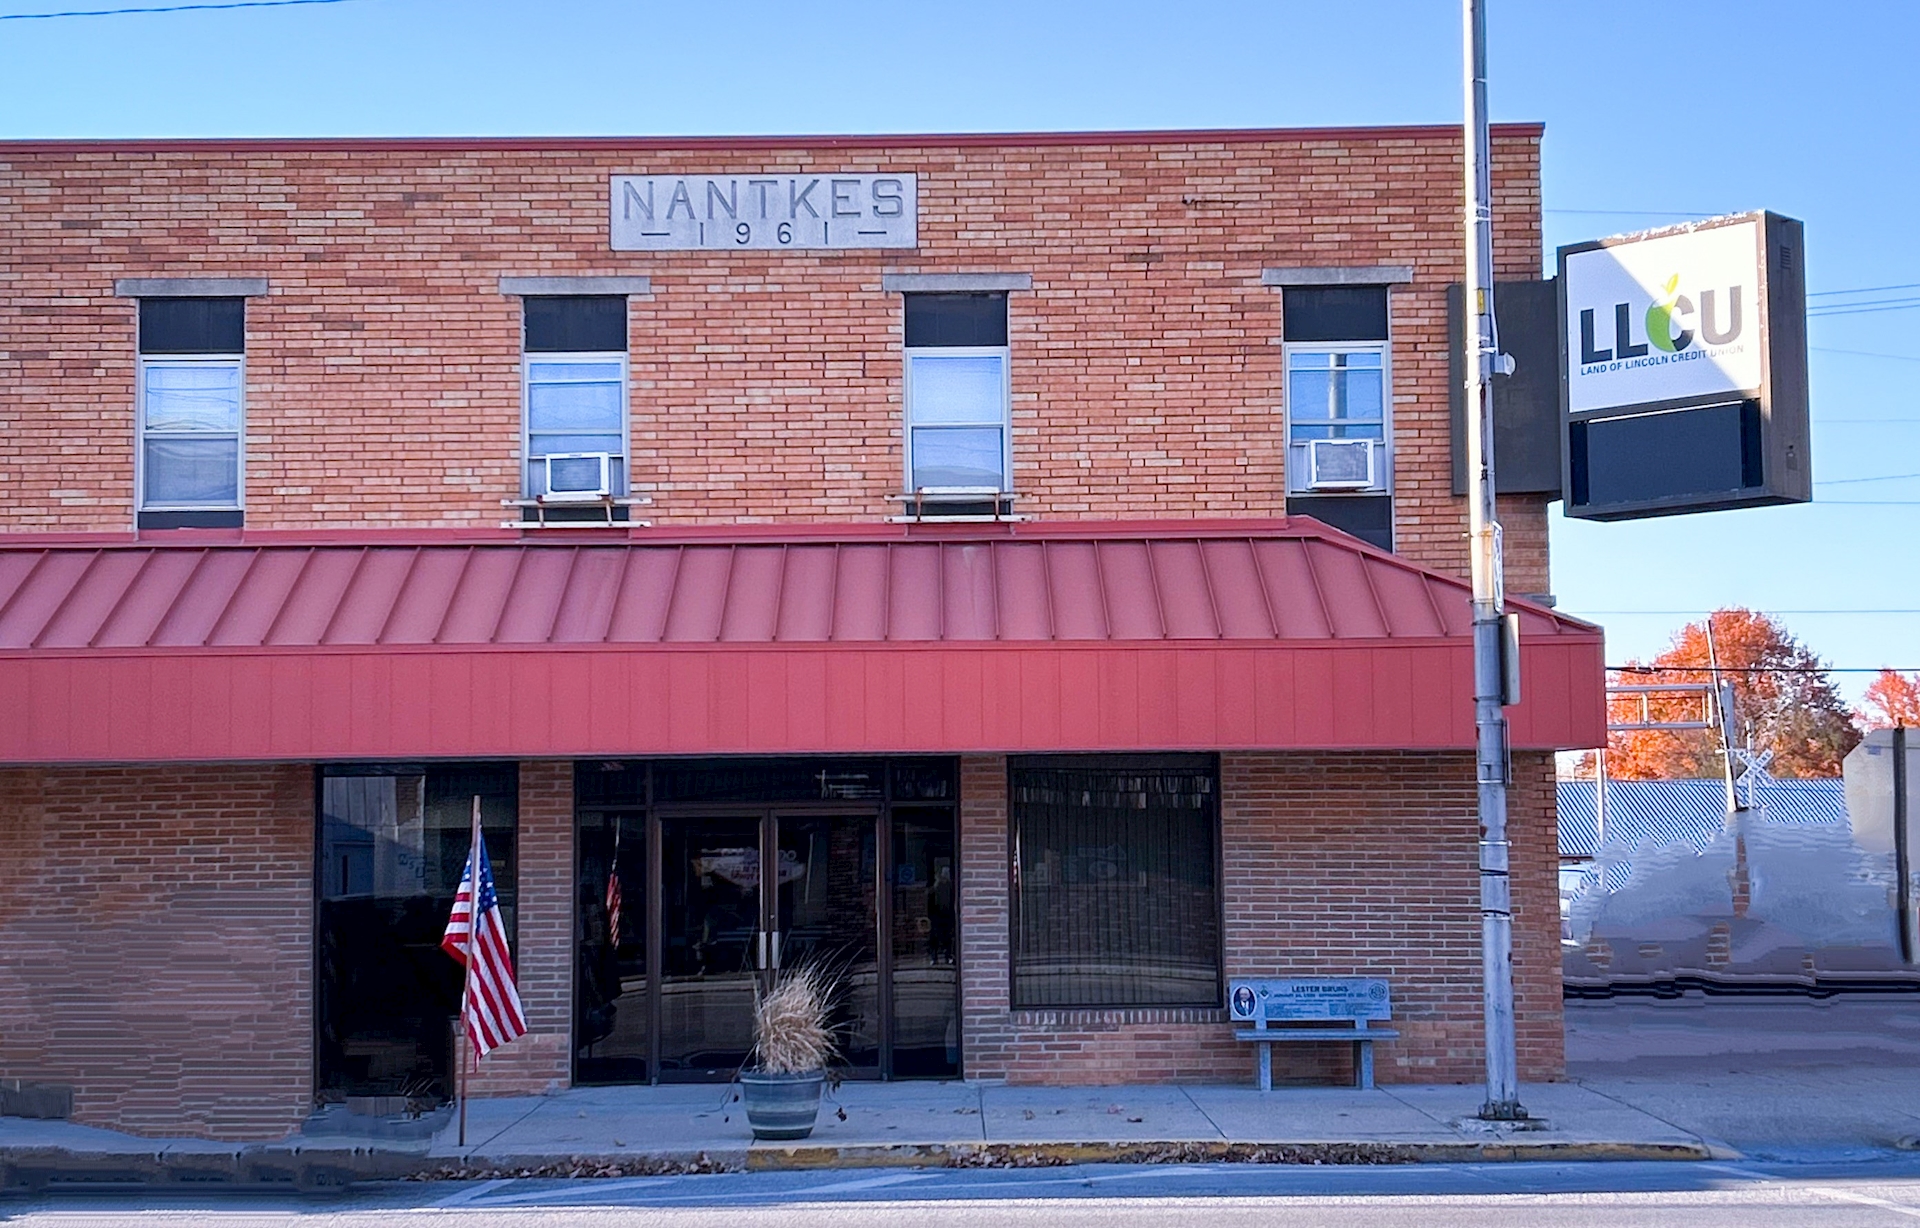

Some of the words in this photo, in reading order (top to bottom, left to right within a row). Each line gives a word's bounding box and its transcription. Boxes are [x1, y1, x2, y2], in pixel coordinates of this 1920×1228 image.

[623, 179, 903, 220] NANTKES
[1580, 285, 1743, 365] LLCU
[1581, 364, 1607, 376] LAND
[1610, 362, 1623, 372] OF
[1625, 355, 1668, 370] LINCOLN
[1671, 349, 1707, 363] CREDIT
[1710, 345, 1744, 358] UNION
